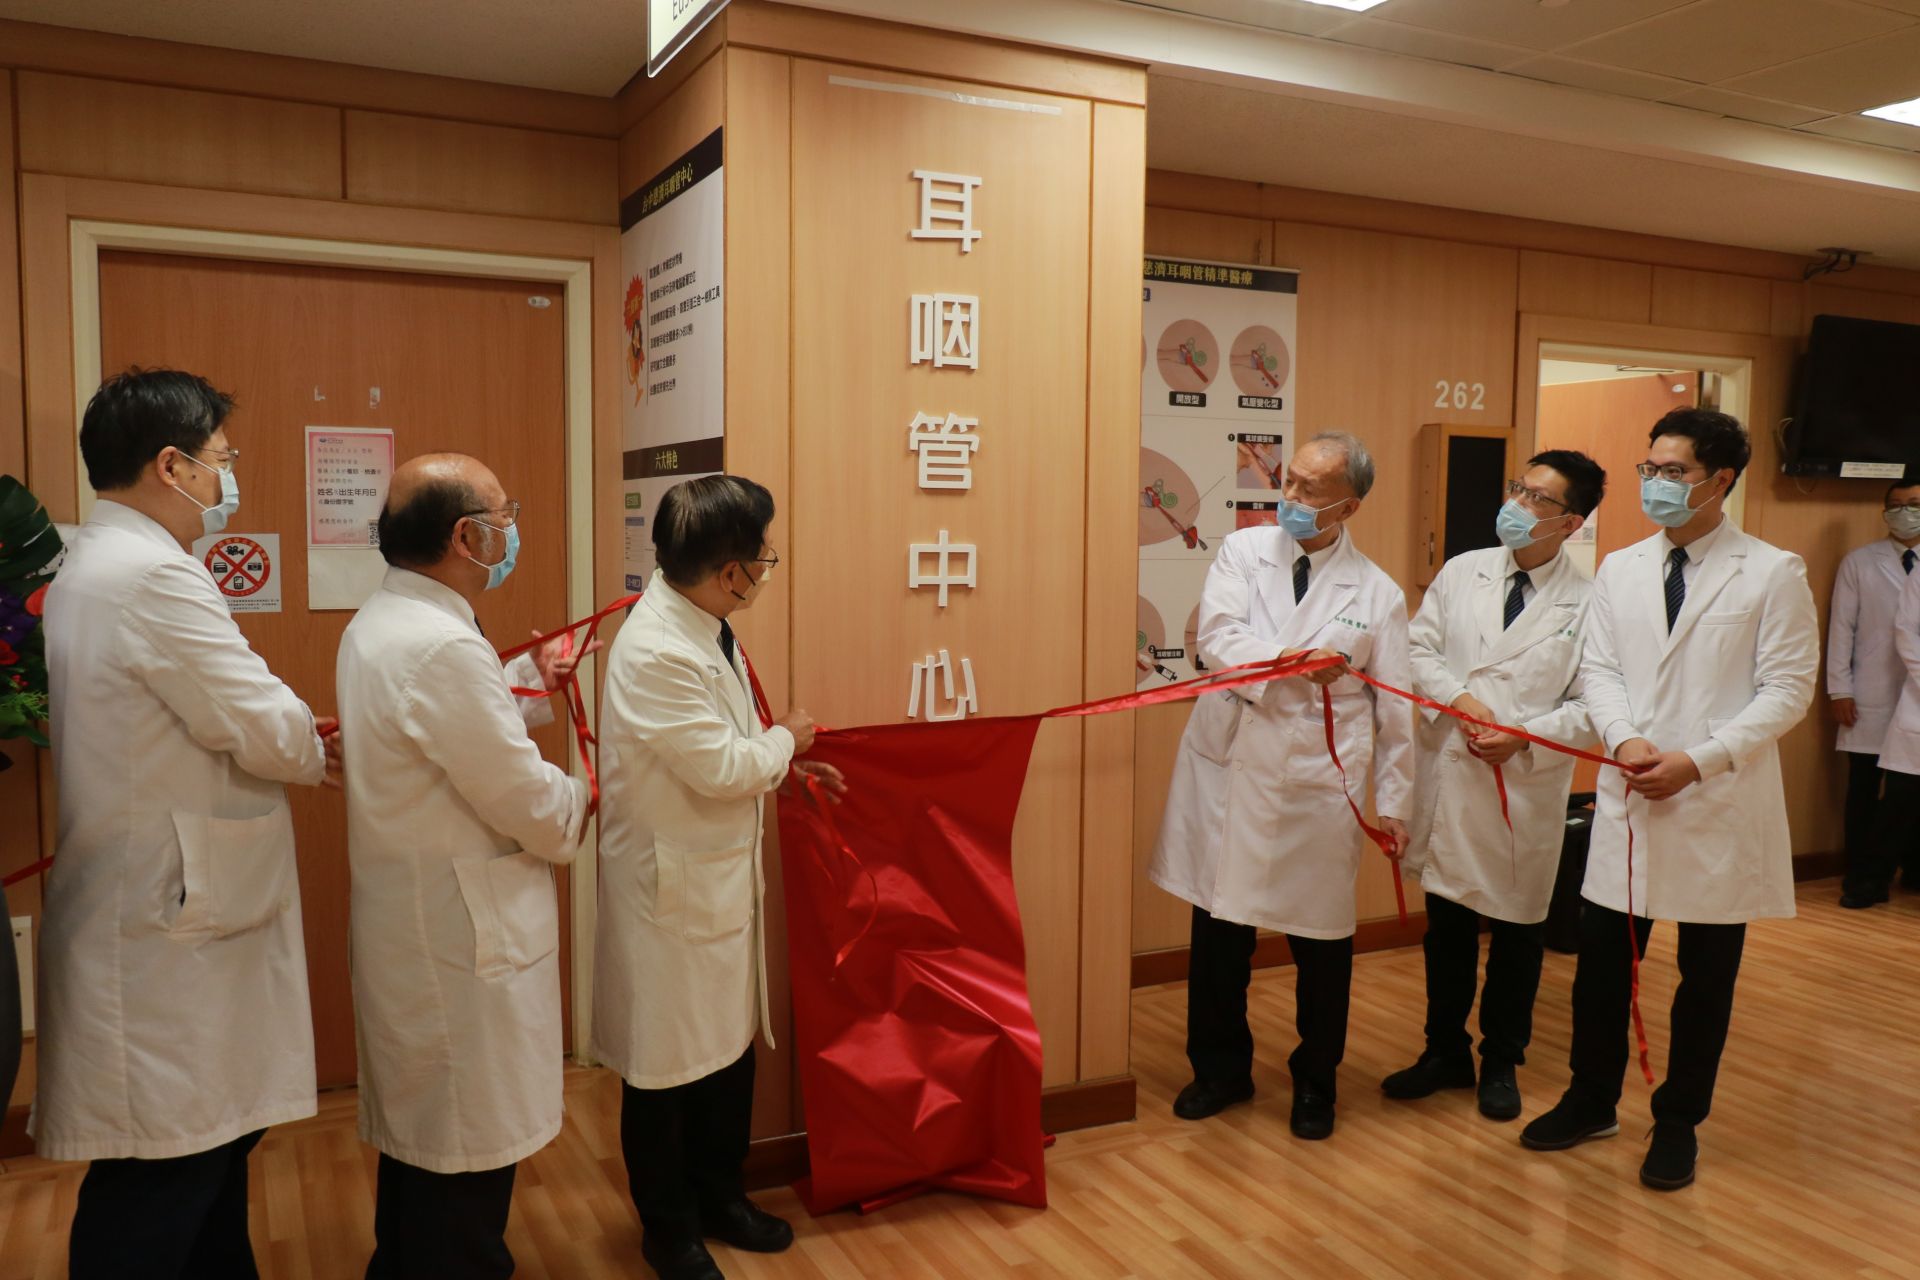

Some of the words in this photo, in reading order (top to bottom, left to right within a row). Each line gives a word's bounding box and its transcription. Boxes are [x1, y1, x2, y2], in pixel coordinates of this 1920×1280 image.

[908, 168, 983, 723] 耳咽管中心
[1434, 380, 1485, 410] 262
